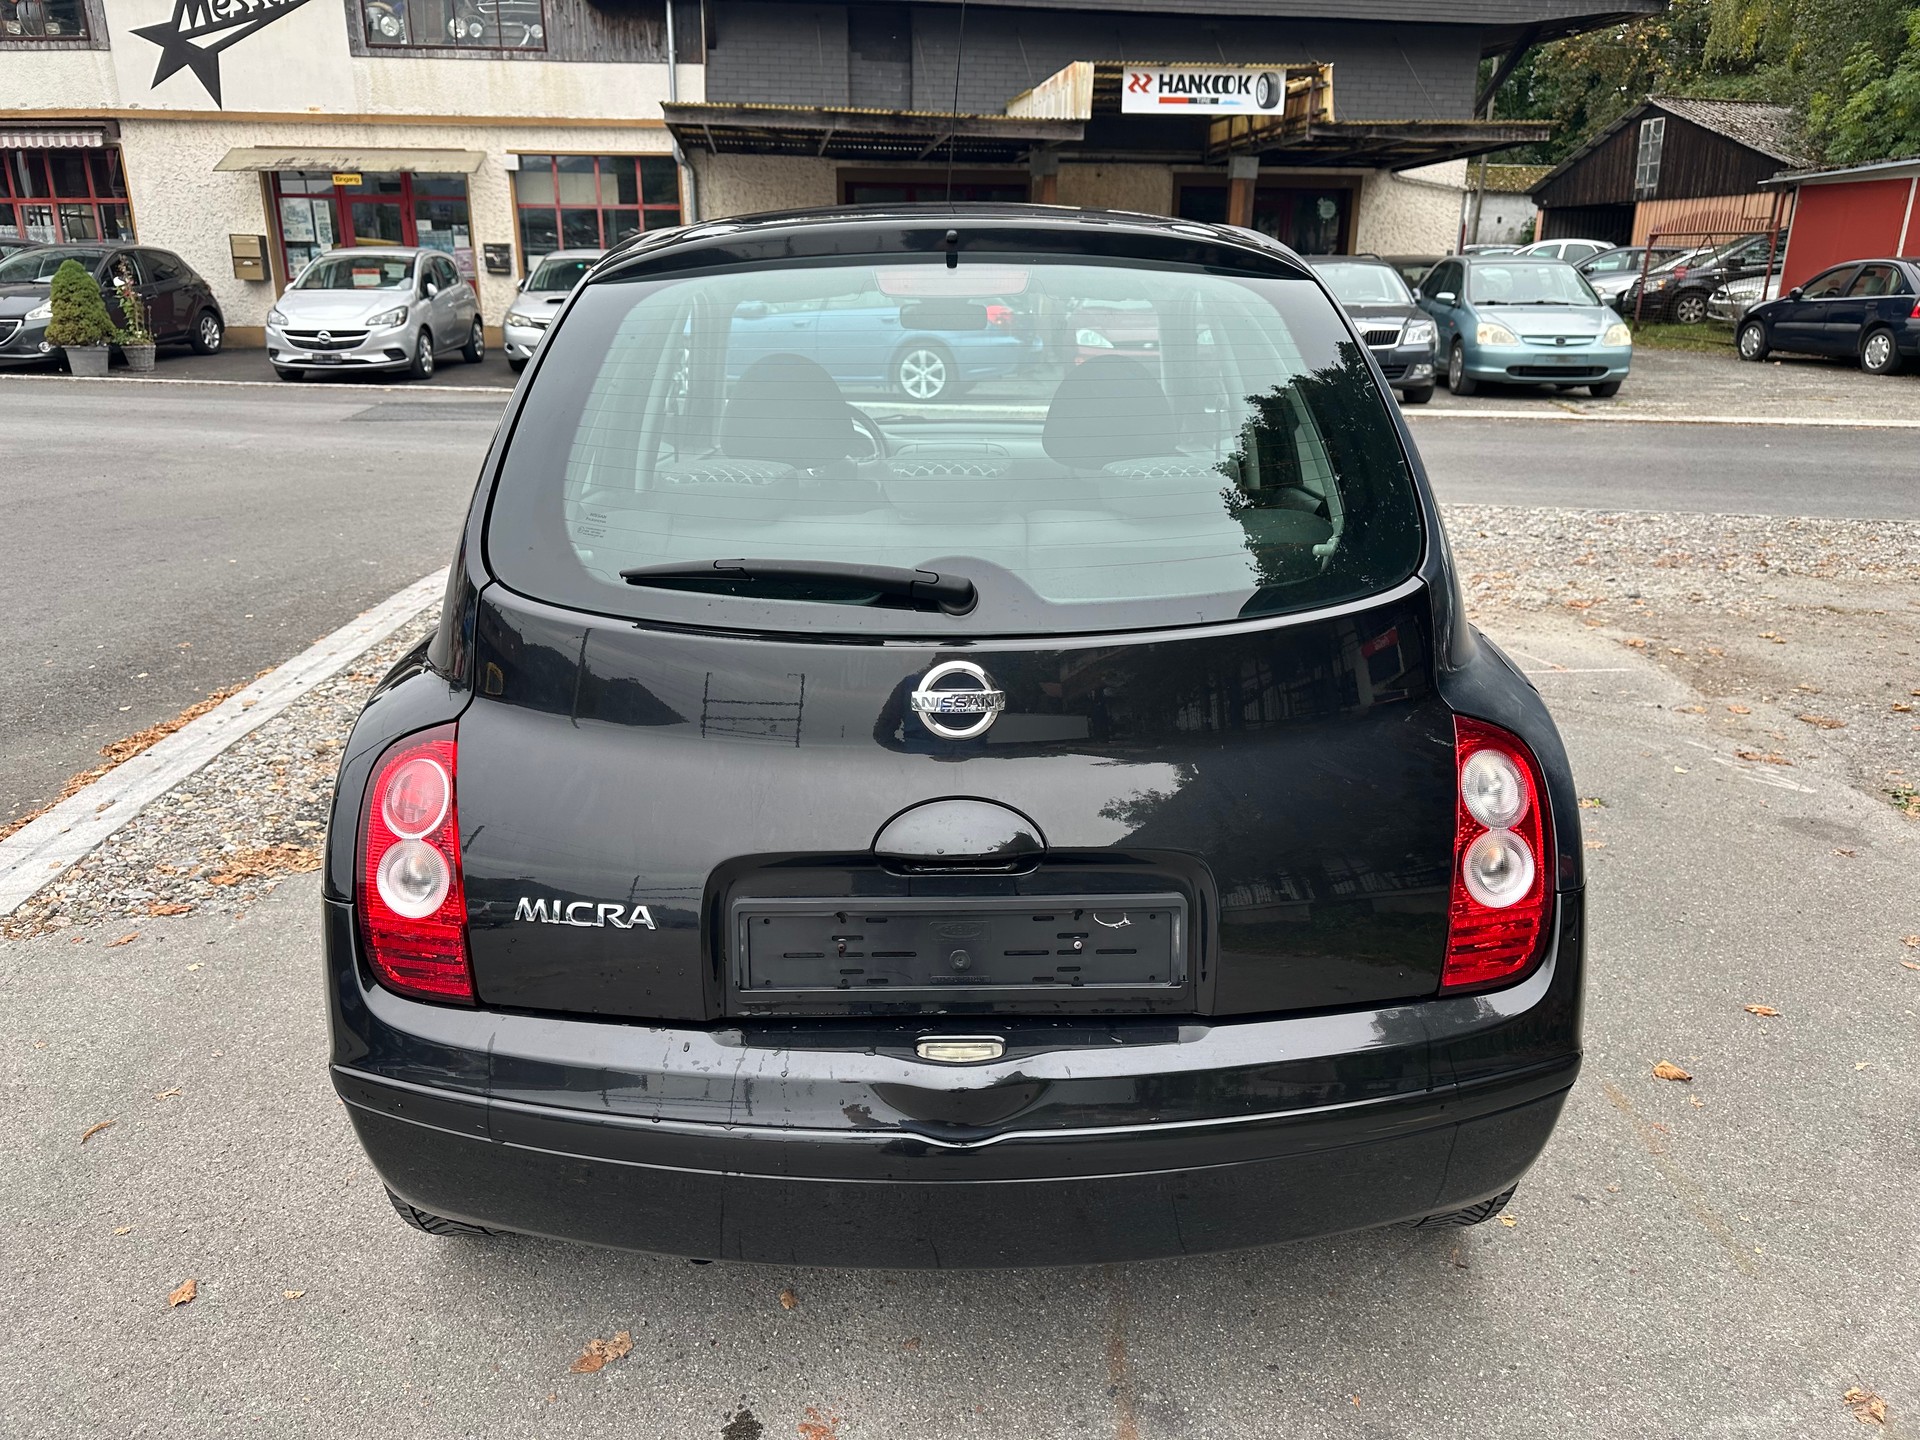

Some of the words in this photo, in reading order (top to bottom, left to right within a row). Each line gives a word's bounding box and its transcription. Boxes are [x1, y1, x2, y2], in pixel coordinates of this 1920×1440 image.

[1158, 74, 1252, 94] HANKOOK
[921, 695, 996, 708] NISSAN
[514, 897, 656, 930] MICRA
